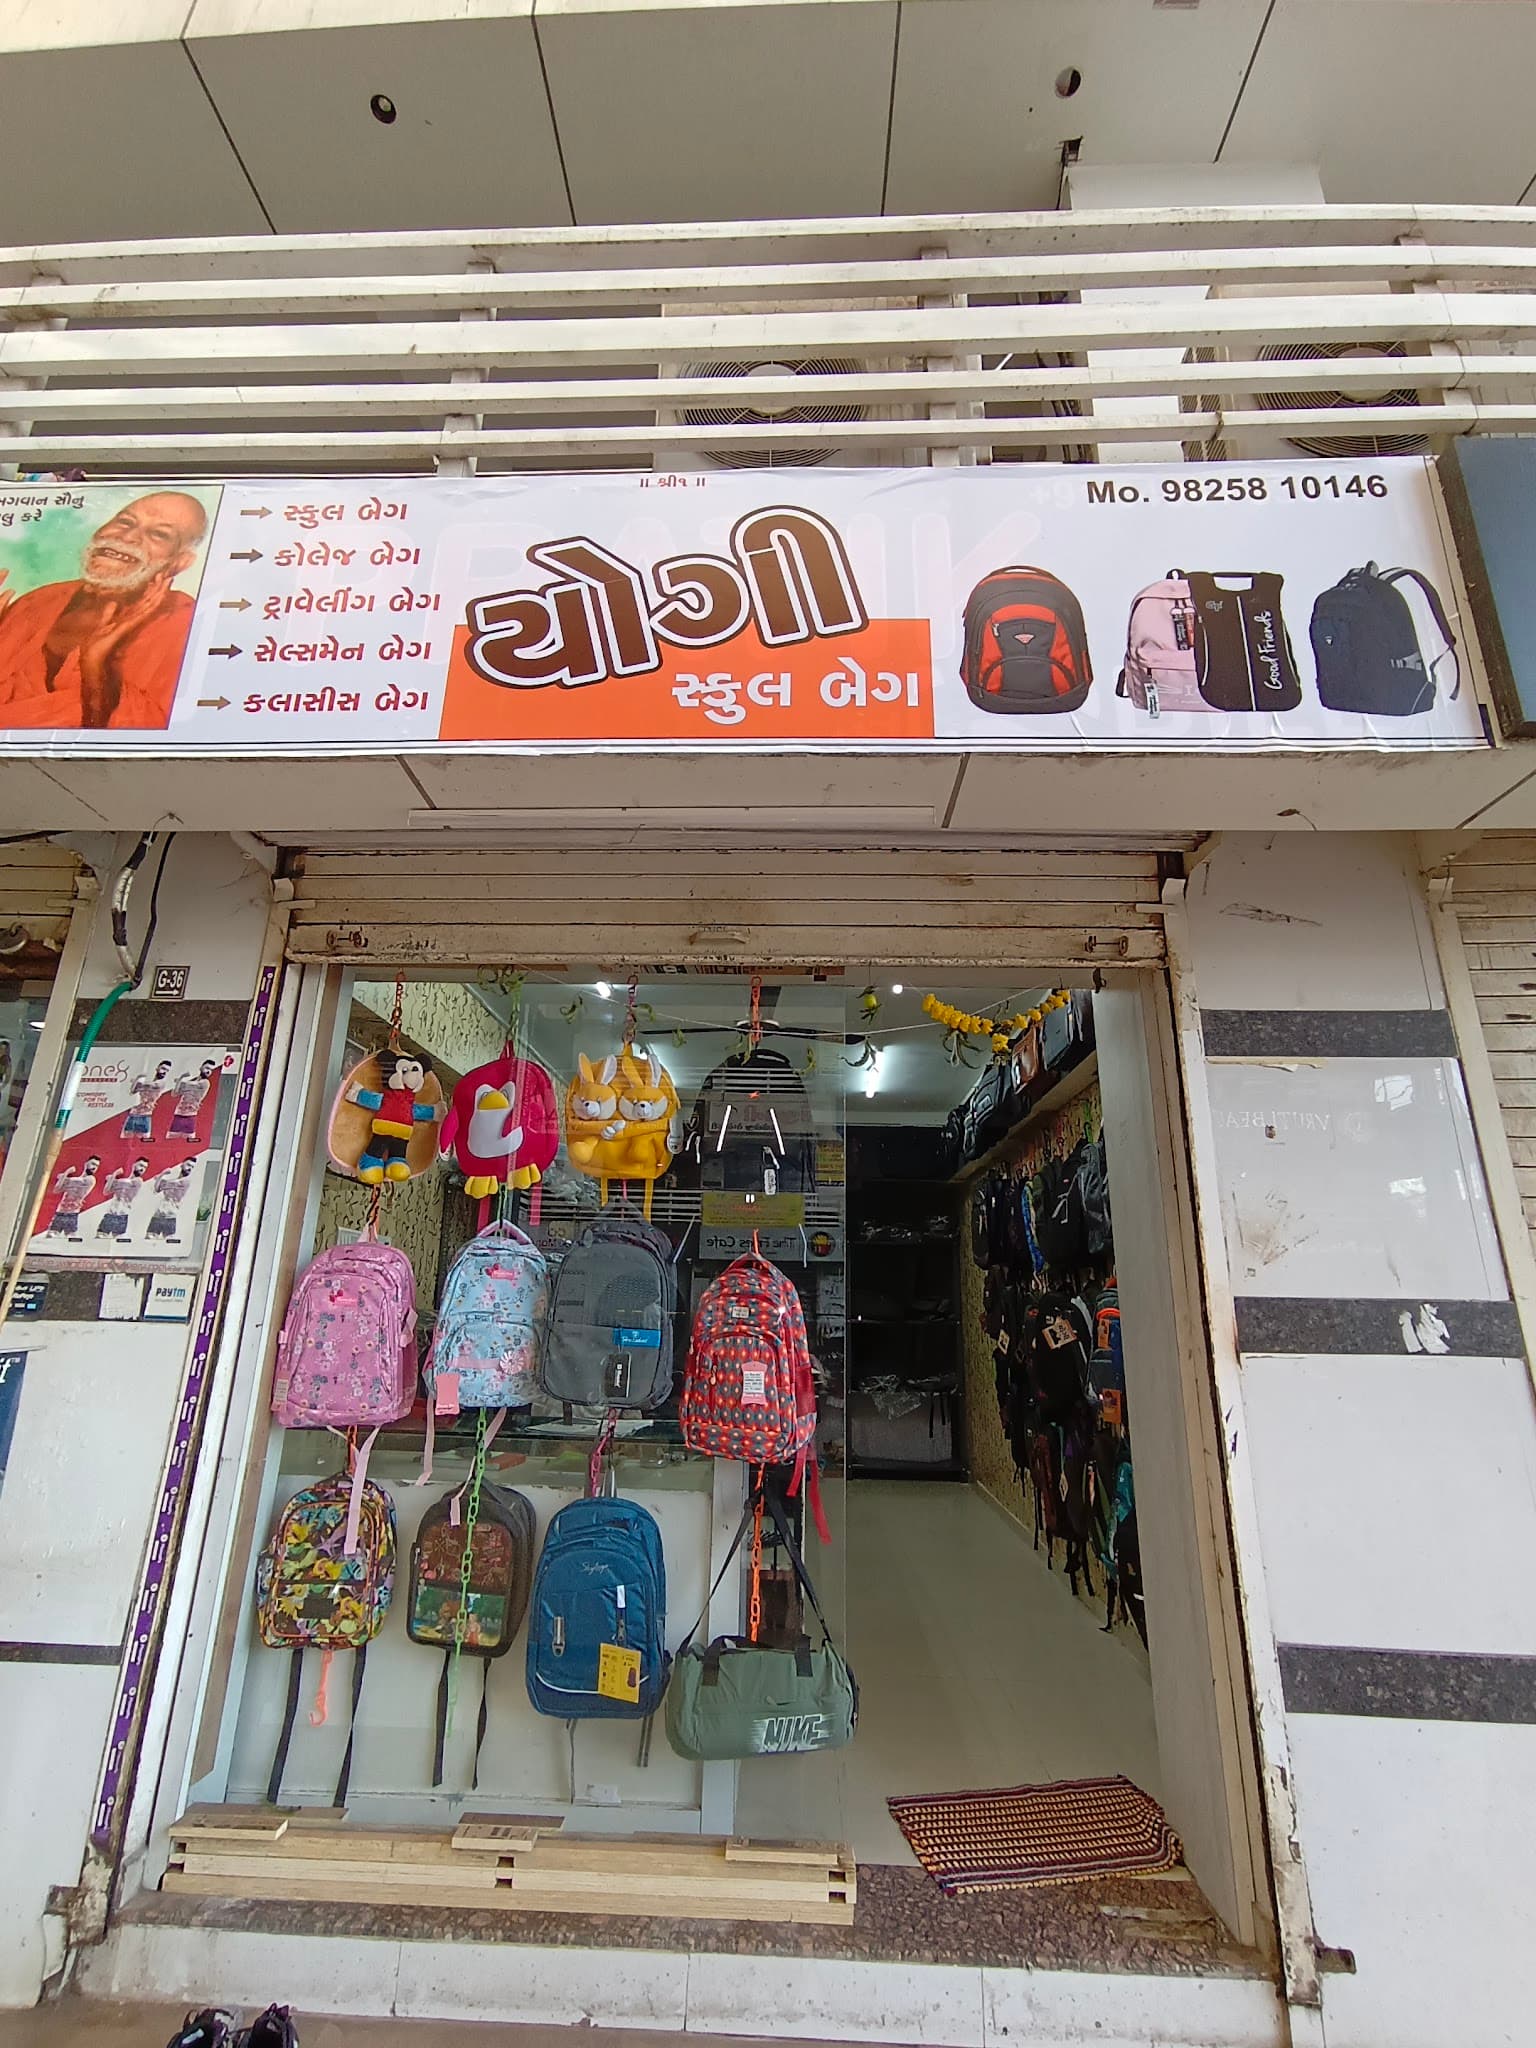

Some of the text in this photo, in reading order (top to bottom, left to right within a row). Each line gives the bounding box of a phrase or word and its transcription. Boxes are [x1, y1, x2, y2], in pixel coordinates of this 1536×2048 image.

[1087, 474, 1389, 505] Mo. 98258 10146
[283, 496, 408, 529] સ્કુલ બેગ
[274, 540, 421, 567] કોલેજ બેગ
[262, 586, 441, 620] ટ્રાવેલીંગ બેગ
[463, 504, 869, 690] યોગી
[254, 633, 432, 662] સેલ્સમેન બેગ
[1254, 610, 1283, 690] Good Friends
[243, 683, 429, 713] કલાસીસ બેગ
[671, 656, 920, 725] સ્કુલ બેગ
[158, 970, 184, 988] G-36
[759, 1714, 824, 1753] NIKE
